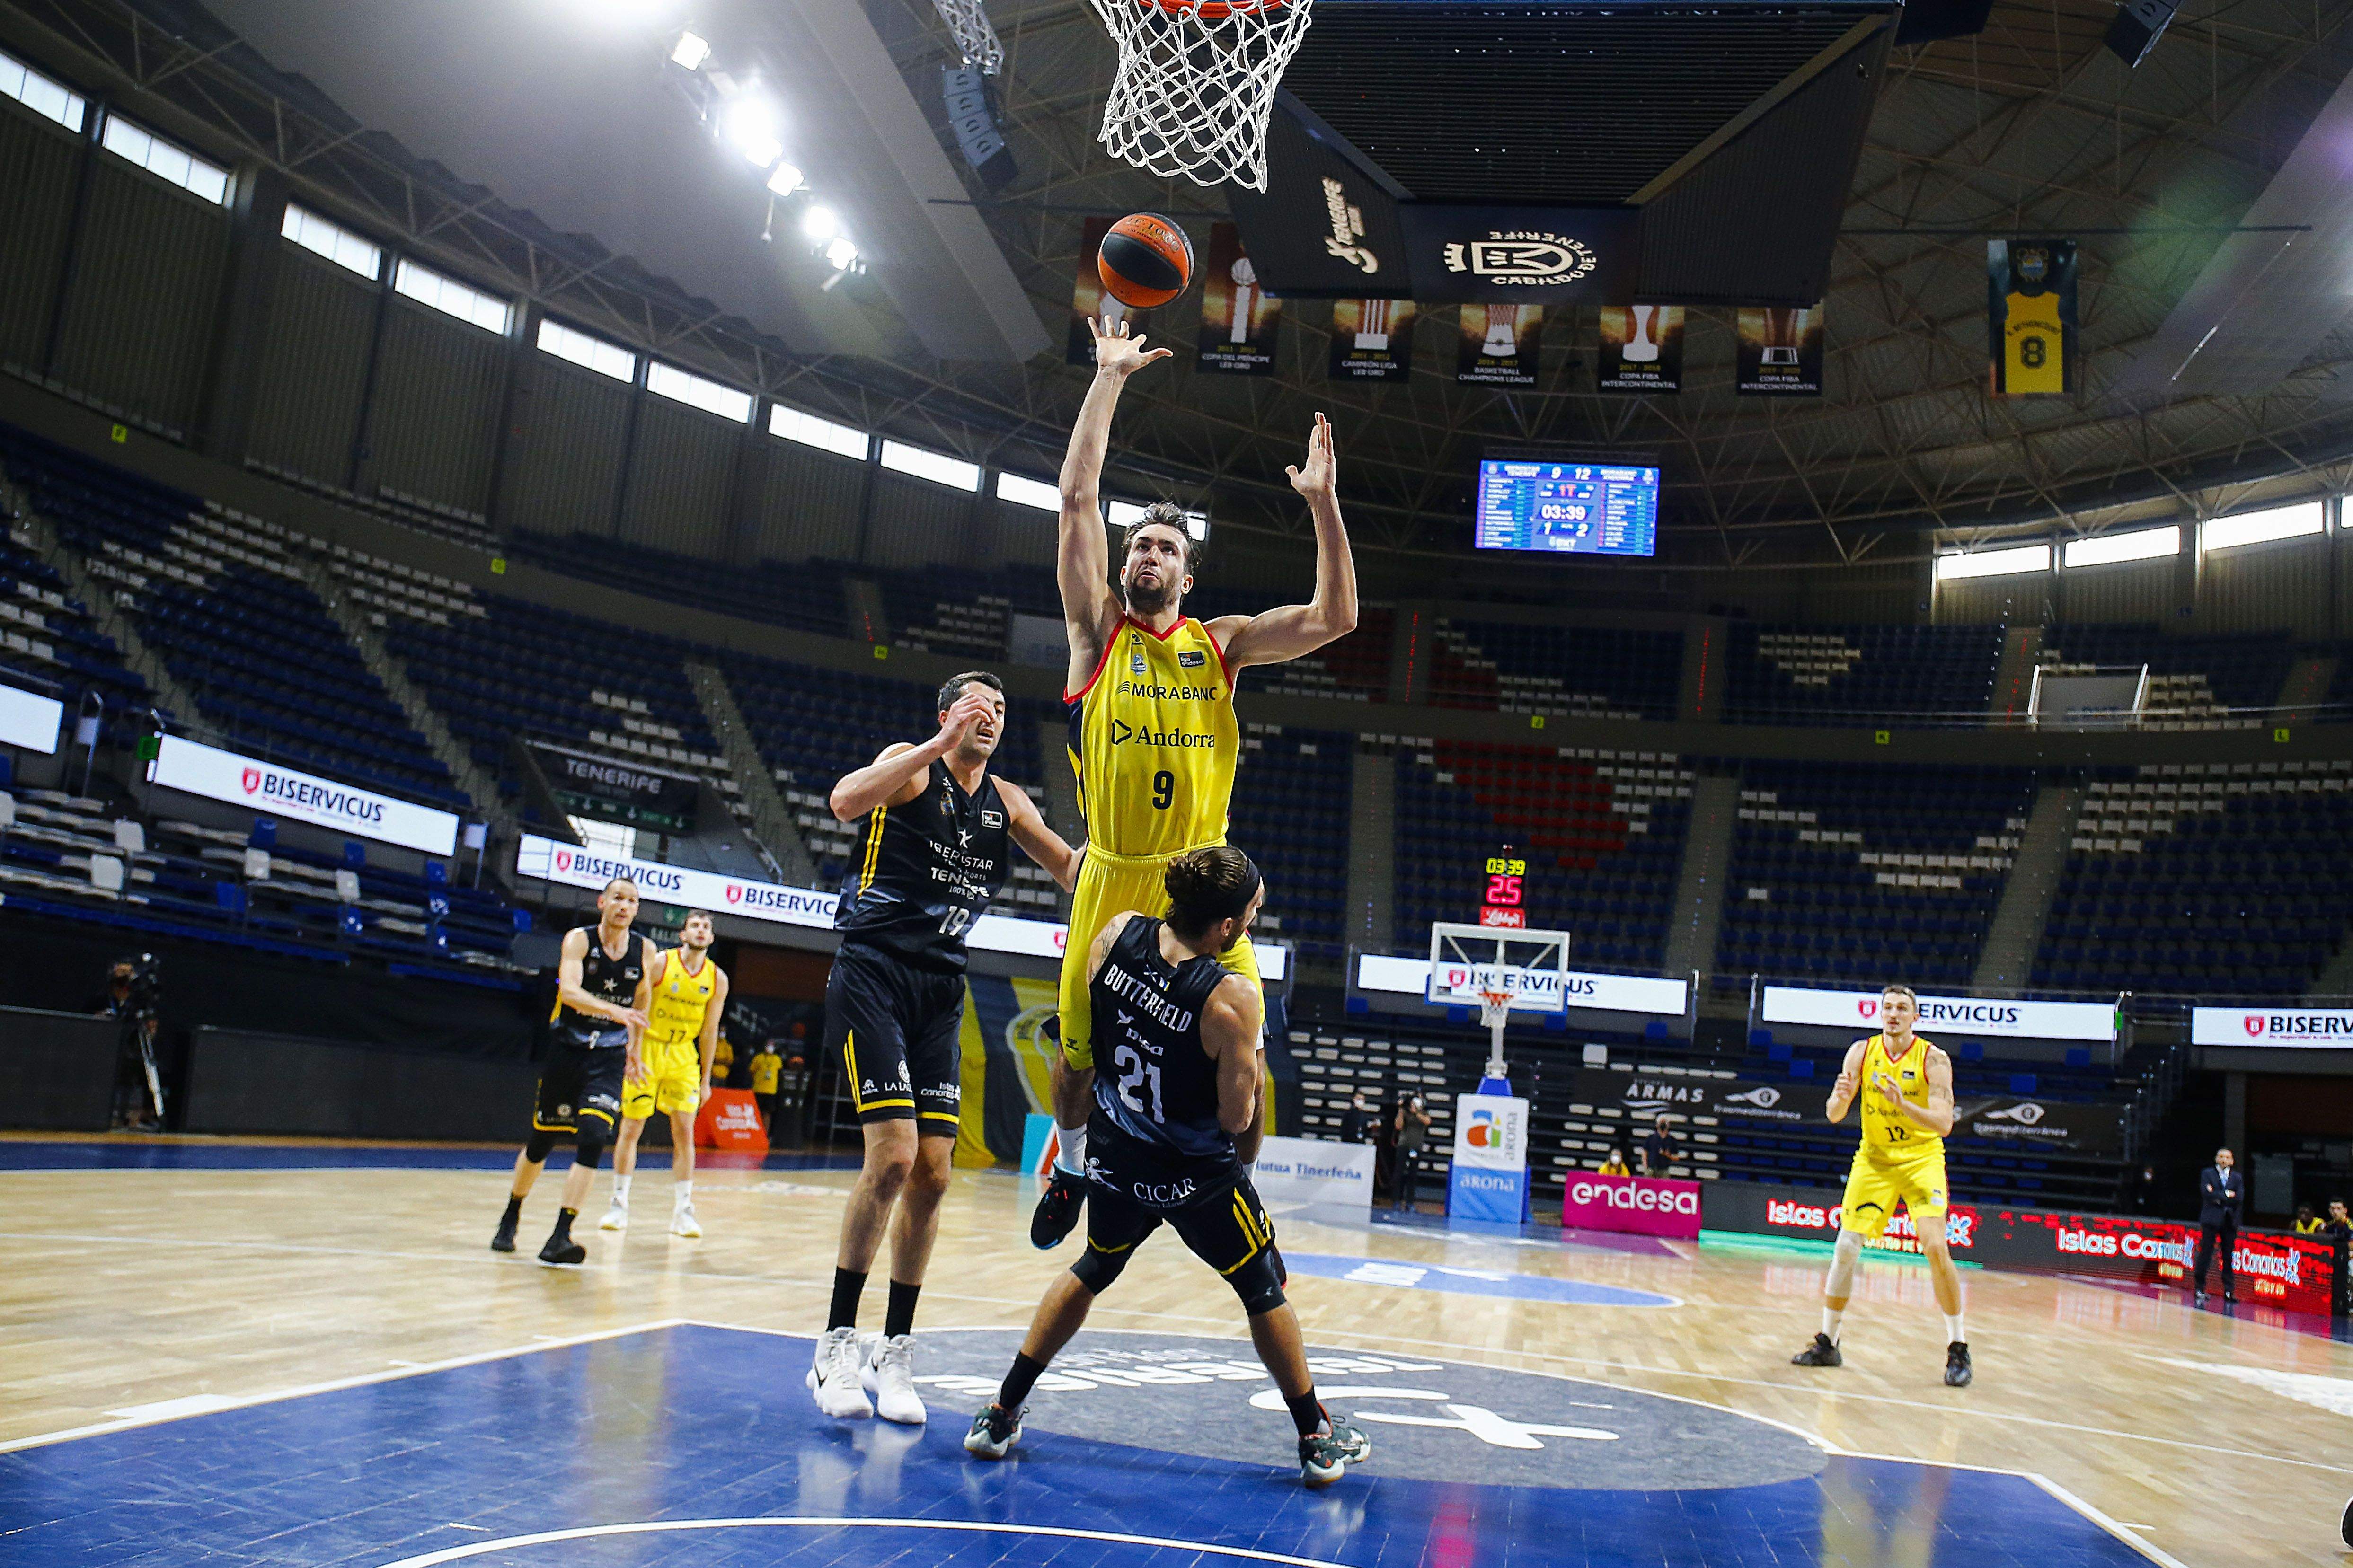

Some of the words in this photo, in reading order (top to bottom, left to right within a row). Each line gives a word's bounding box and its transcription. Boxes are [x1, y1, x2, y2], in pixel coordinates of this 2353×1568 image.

[1489, 231, 1592, 257] TENERIFE
[1491, 270, 1585, 285] CABILDO
[2020, 336, 2047, 369] 8
[1601, 380, 1677, 389] INTERCONTINENTAL
[1740, 383, 1818, 391] INTERCONTINENTAL
[1551, 466, 1562, 479] 9
[1575, 467, 1592, 481] 12
[1541, 504, 1586, 520] 03:39
[1575, 523, 1589, 537] 2
[1132, 682, 1217, 701] MORABANC
[1134, 727, 1214, 748] Andorra
[566, 758, 663, 795] TENERIFE
[264, 773, 386, 822] BISERVICUS
[1152, 770, 1175, 810] 9
[575, 854, 682, 890] BISERVICUS
[745, 888, 837, 916] BISERVIC
[939, 905, 970, 936] 19
[1104, 963, 1193, 1032] BUTTERFIELD
[1918, 1003, 2020, 1022] ERVICUS
[2270, 1016, 2353, 1033] BISERV
[669, 1029, 687, 1043] 17
[1115, 1045, 1165, 1124] 21
[1626, 1084, 1704, 1103] ARMAS
[1884, 1126, 1910, 1142] 12
[1297, 1163, 1362, 1180] Tinerfeña
[1133, 1178, 1197, 1202] CICAR
[1571, 1180, 1698, 1216] endesa
[1768, 1200, 1825, 1228] Islas
[2058, 1228, 2118, 1255] Islas
[2241, 1247, 2286, 1277] Canarias
